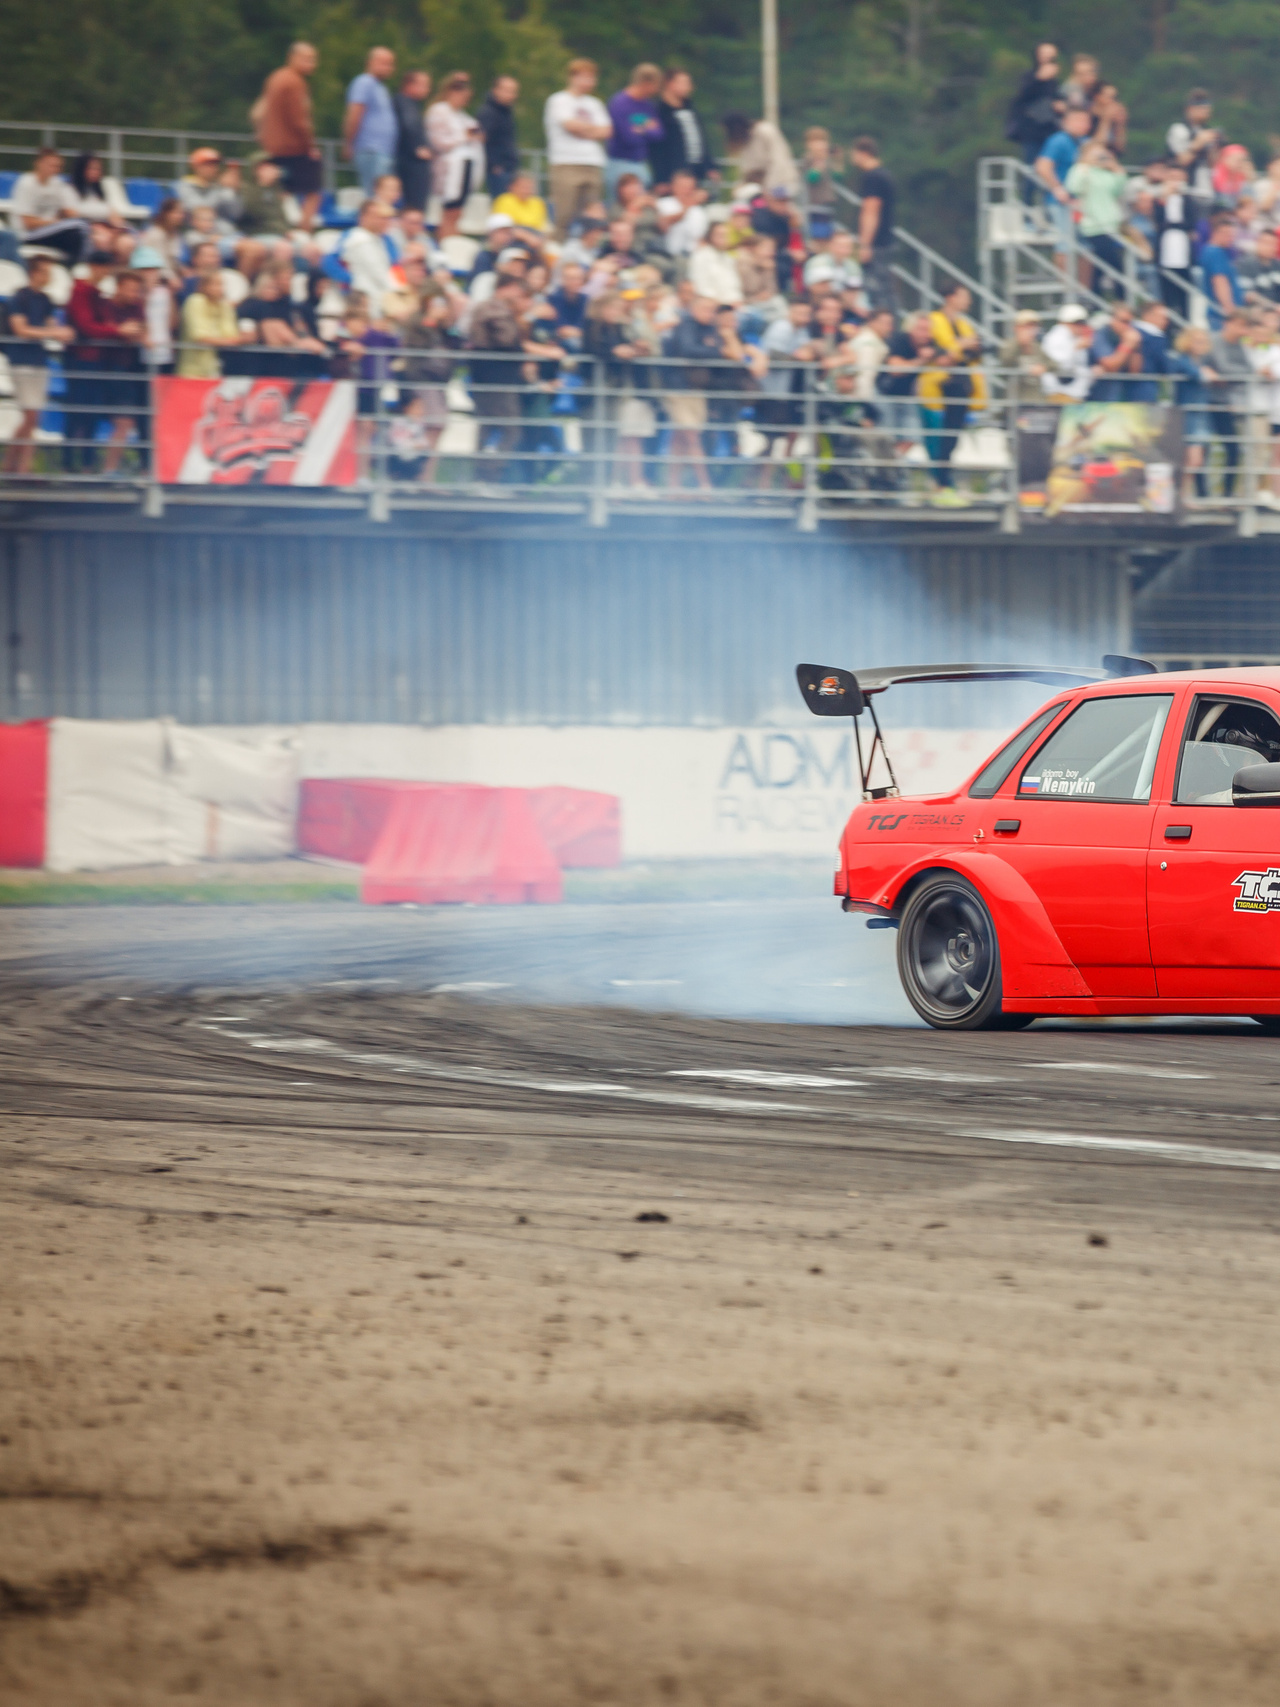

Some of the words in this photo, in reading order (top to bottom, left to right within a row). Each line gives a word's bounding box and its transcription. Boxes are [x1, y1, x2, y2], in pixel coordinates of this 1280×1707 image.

[719, 734, 853, 789] ADM
[1041, 777, 1096, 796] Nemykin
[867, 814, 909, 830] TCS
